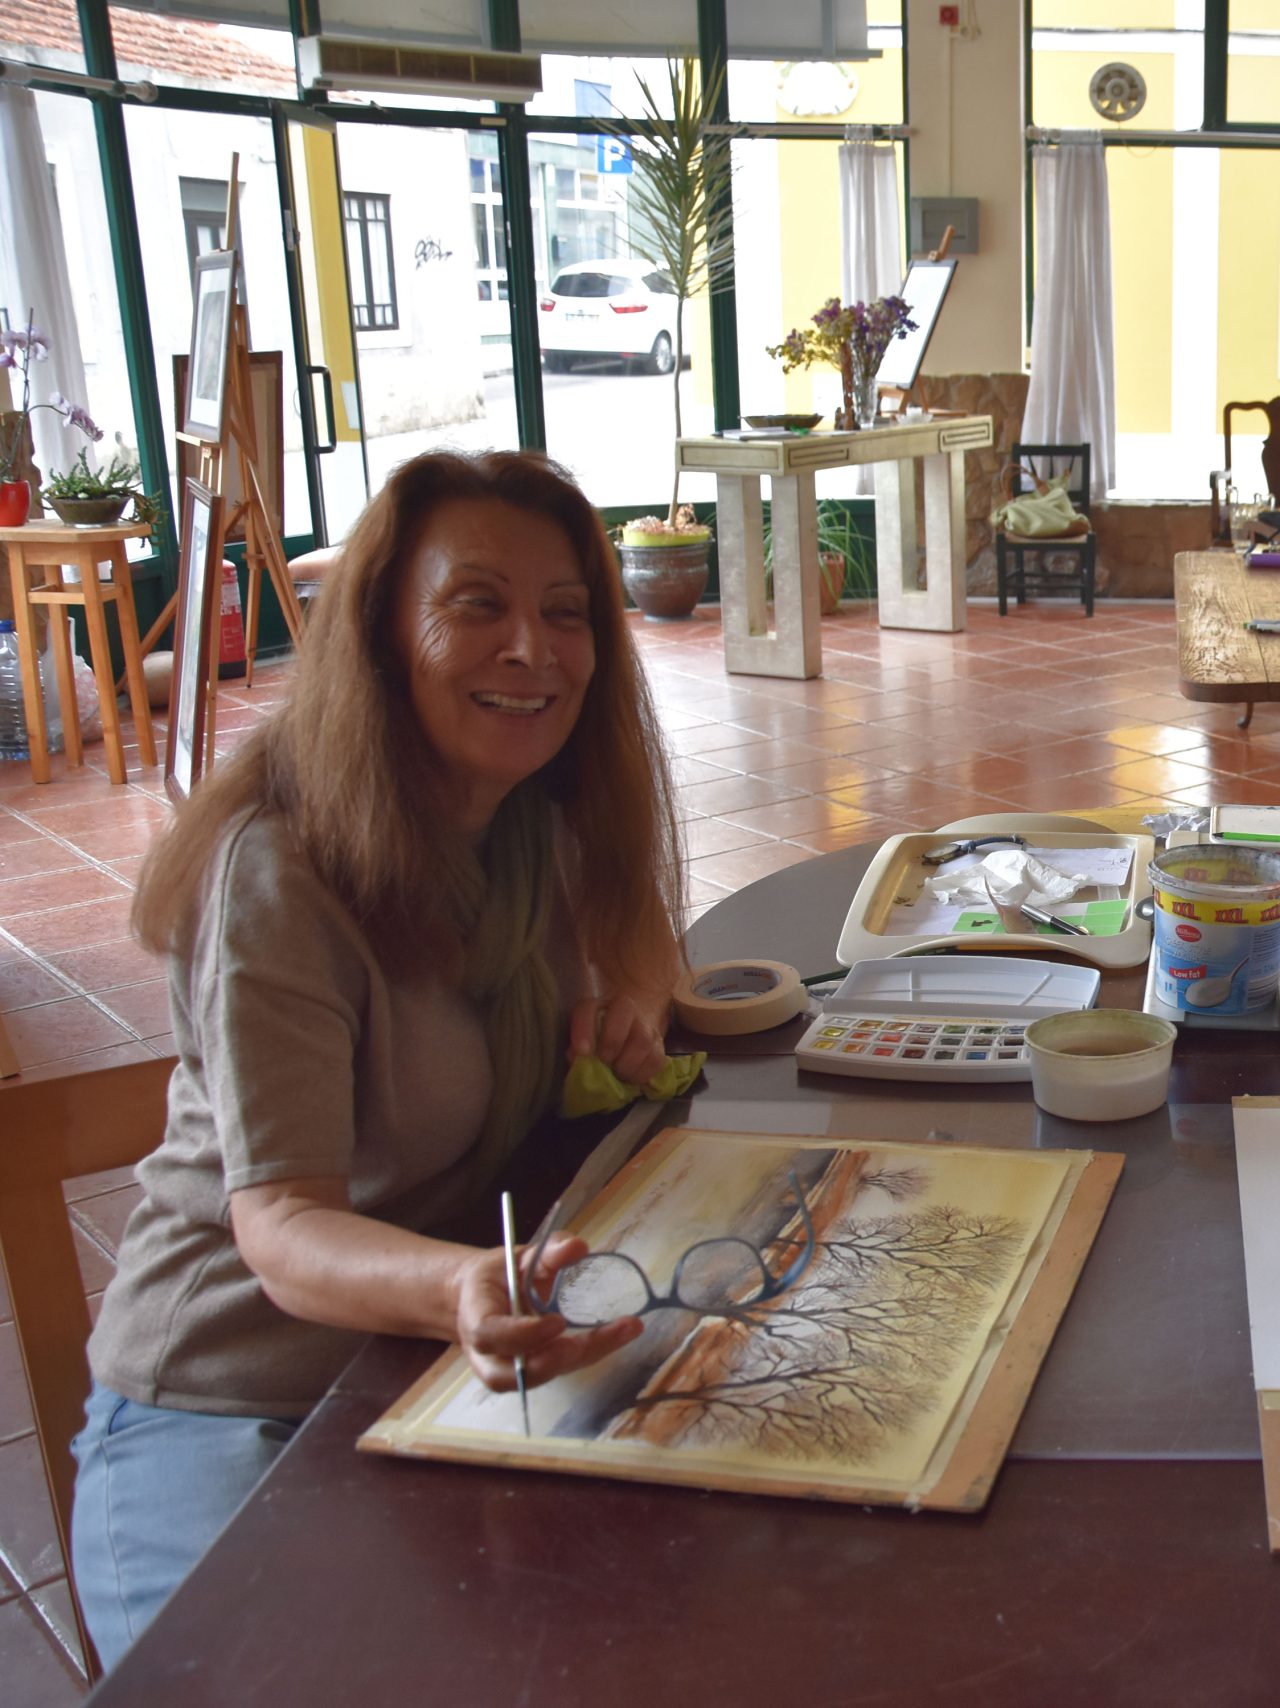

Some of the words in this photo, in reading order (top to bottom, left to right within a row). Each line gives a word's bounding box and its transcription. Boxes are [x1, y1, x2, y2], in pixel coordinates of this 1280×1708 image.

[603, 138, 626, 172] P
[1172, 901, 1201, 921] XXL
[1215, 908, 1249, 924] XXL
[1173, 970, 1187, 979] Low
